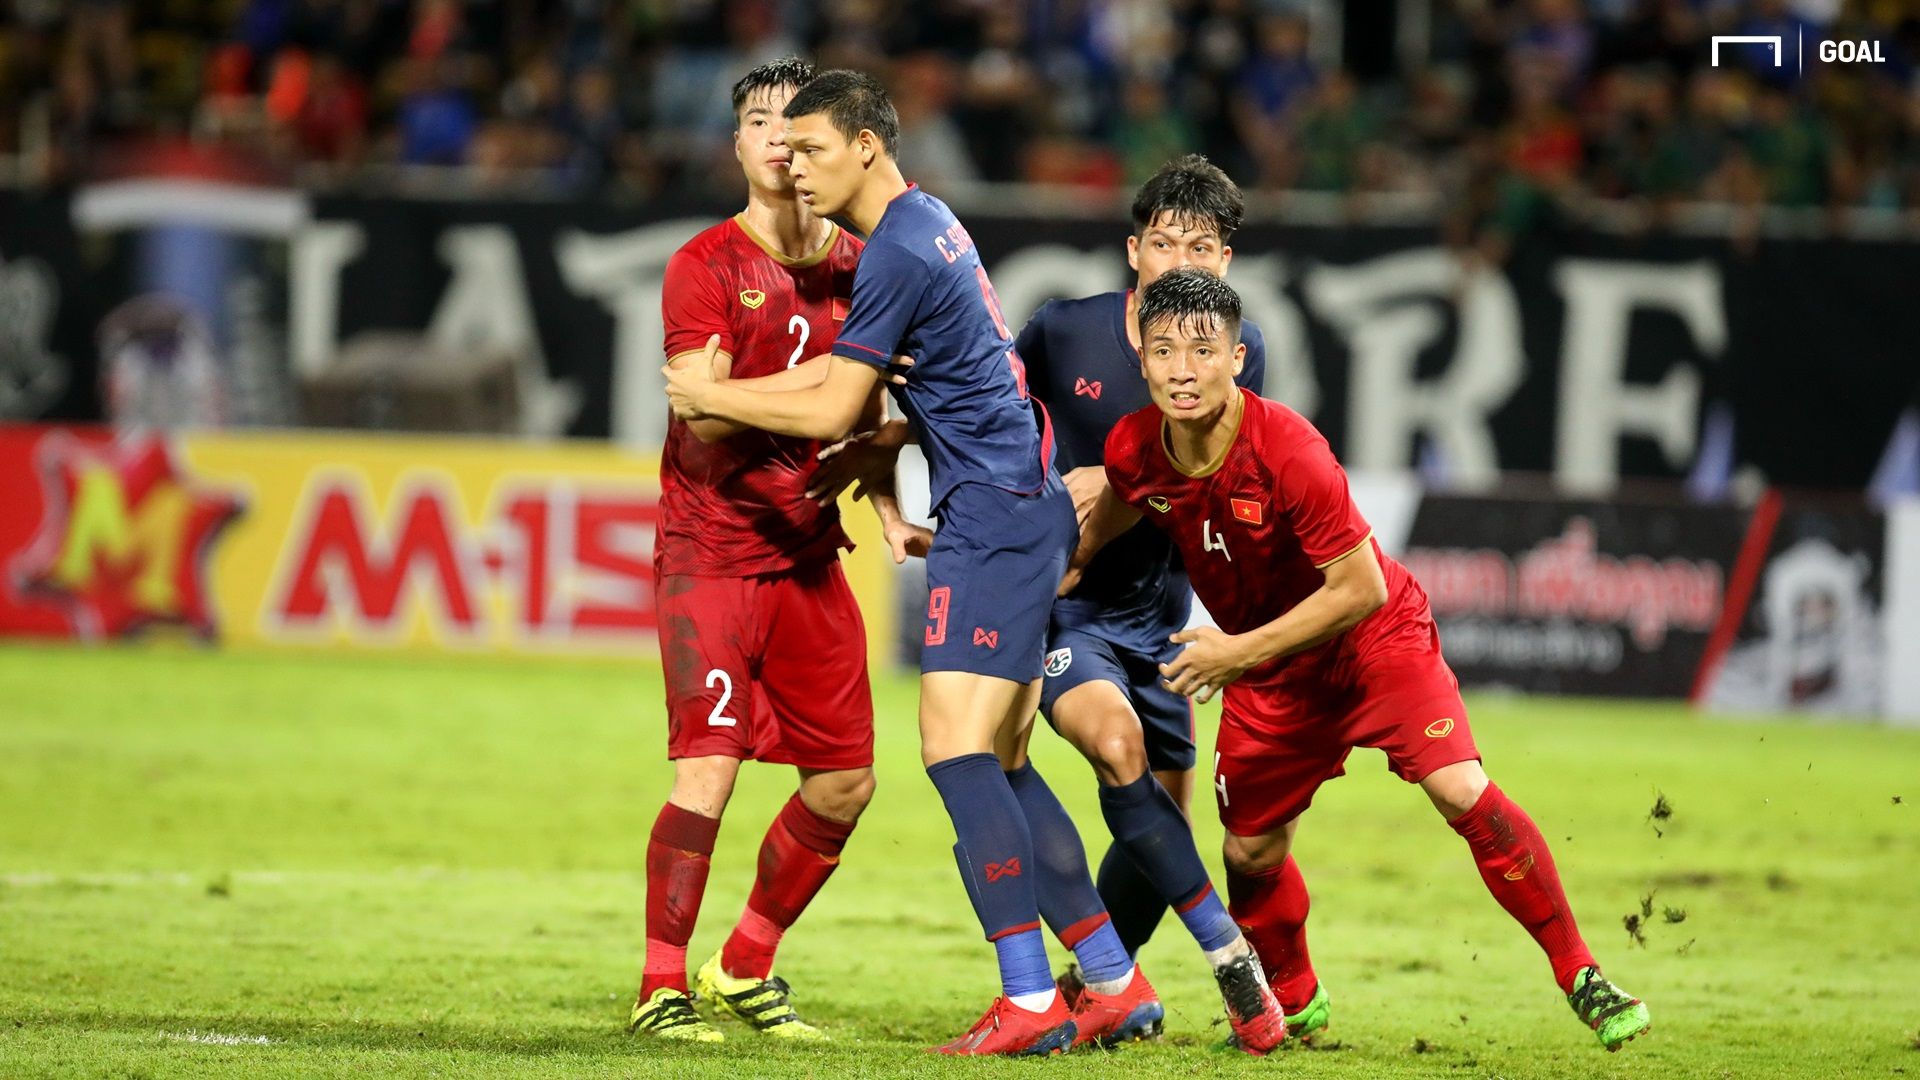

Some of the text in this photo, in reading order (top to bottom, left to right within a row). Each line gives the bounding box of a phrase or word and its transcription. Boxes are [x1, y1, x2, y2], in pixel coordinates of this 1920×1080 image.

[787, 314, 811, 370] 2
[1203, 519, 1232, 562] 4
[924, 586, 951, 647] 9
[705, 668, 737, 727] 2
[1213, 750, 1230, 808] 4
